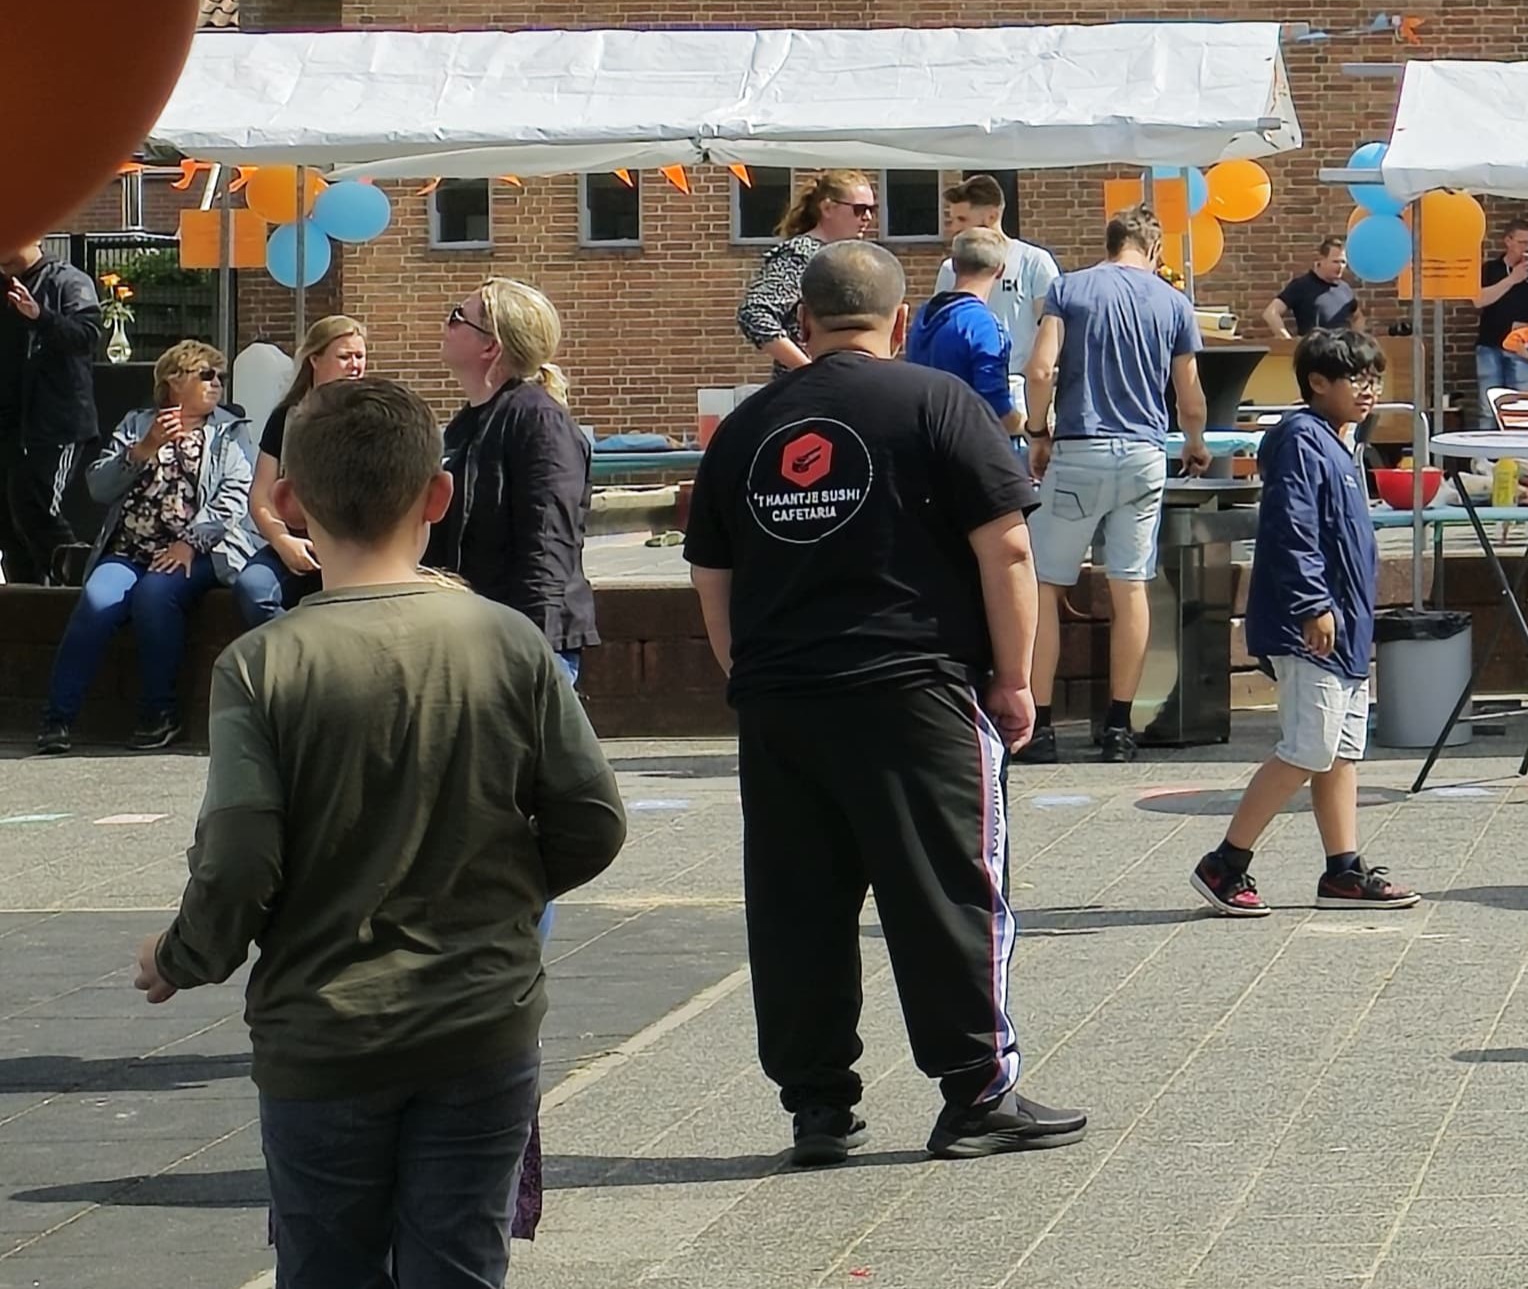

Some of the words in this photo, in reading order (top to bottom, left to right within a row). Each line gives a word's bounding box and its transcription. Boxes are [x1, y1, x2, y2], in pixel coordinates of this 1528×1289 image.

[766, 491, 819, 507] HAANTJE
[821, 488, 861, 503] SUSHI
[772, 505, 837, 522] CAFETARIA
